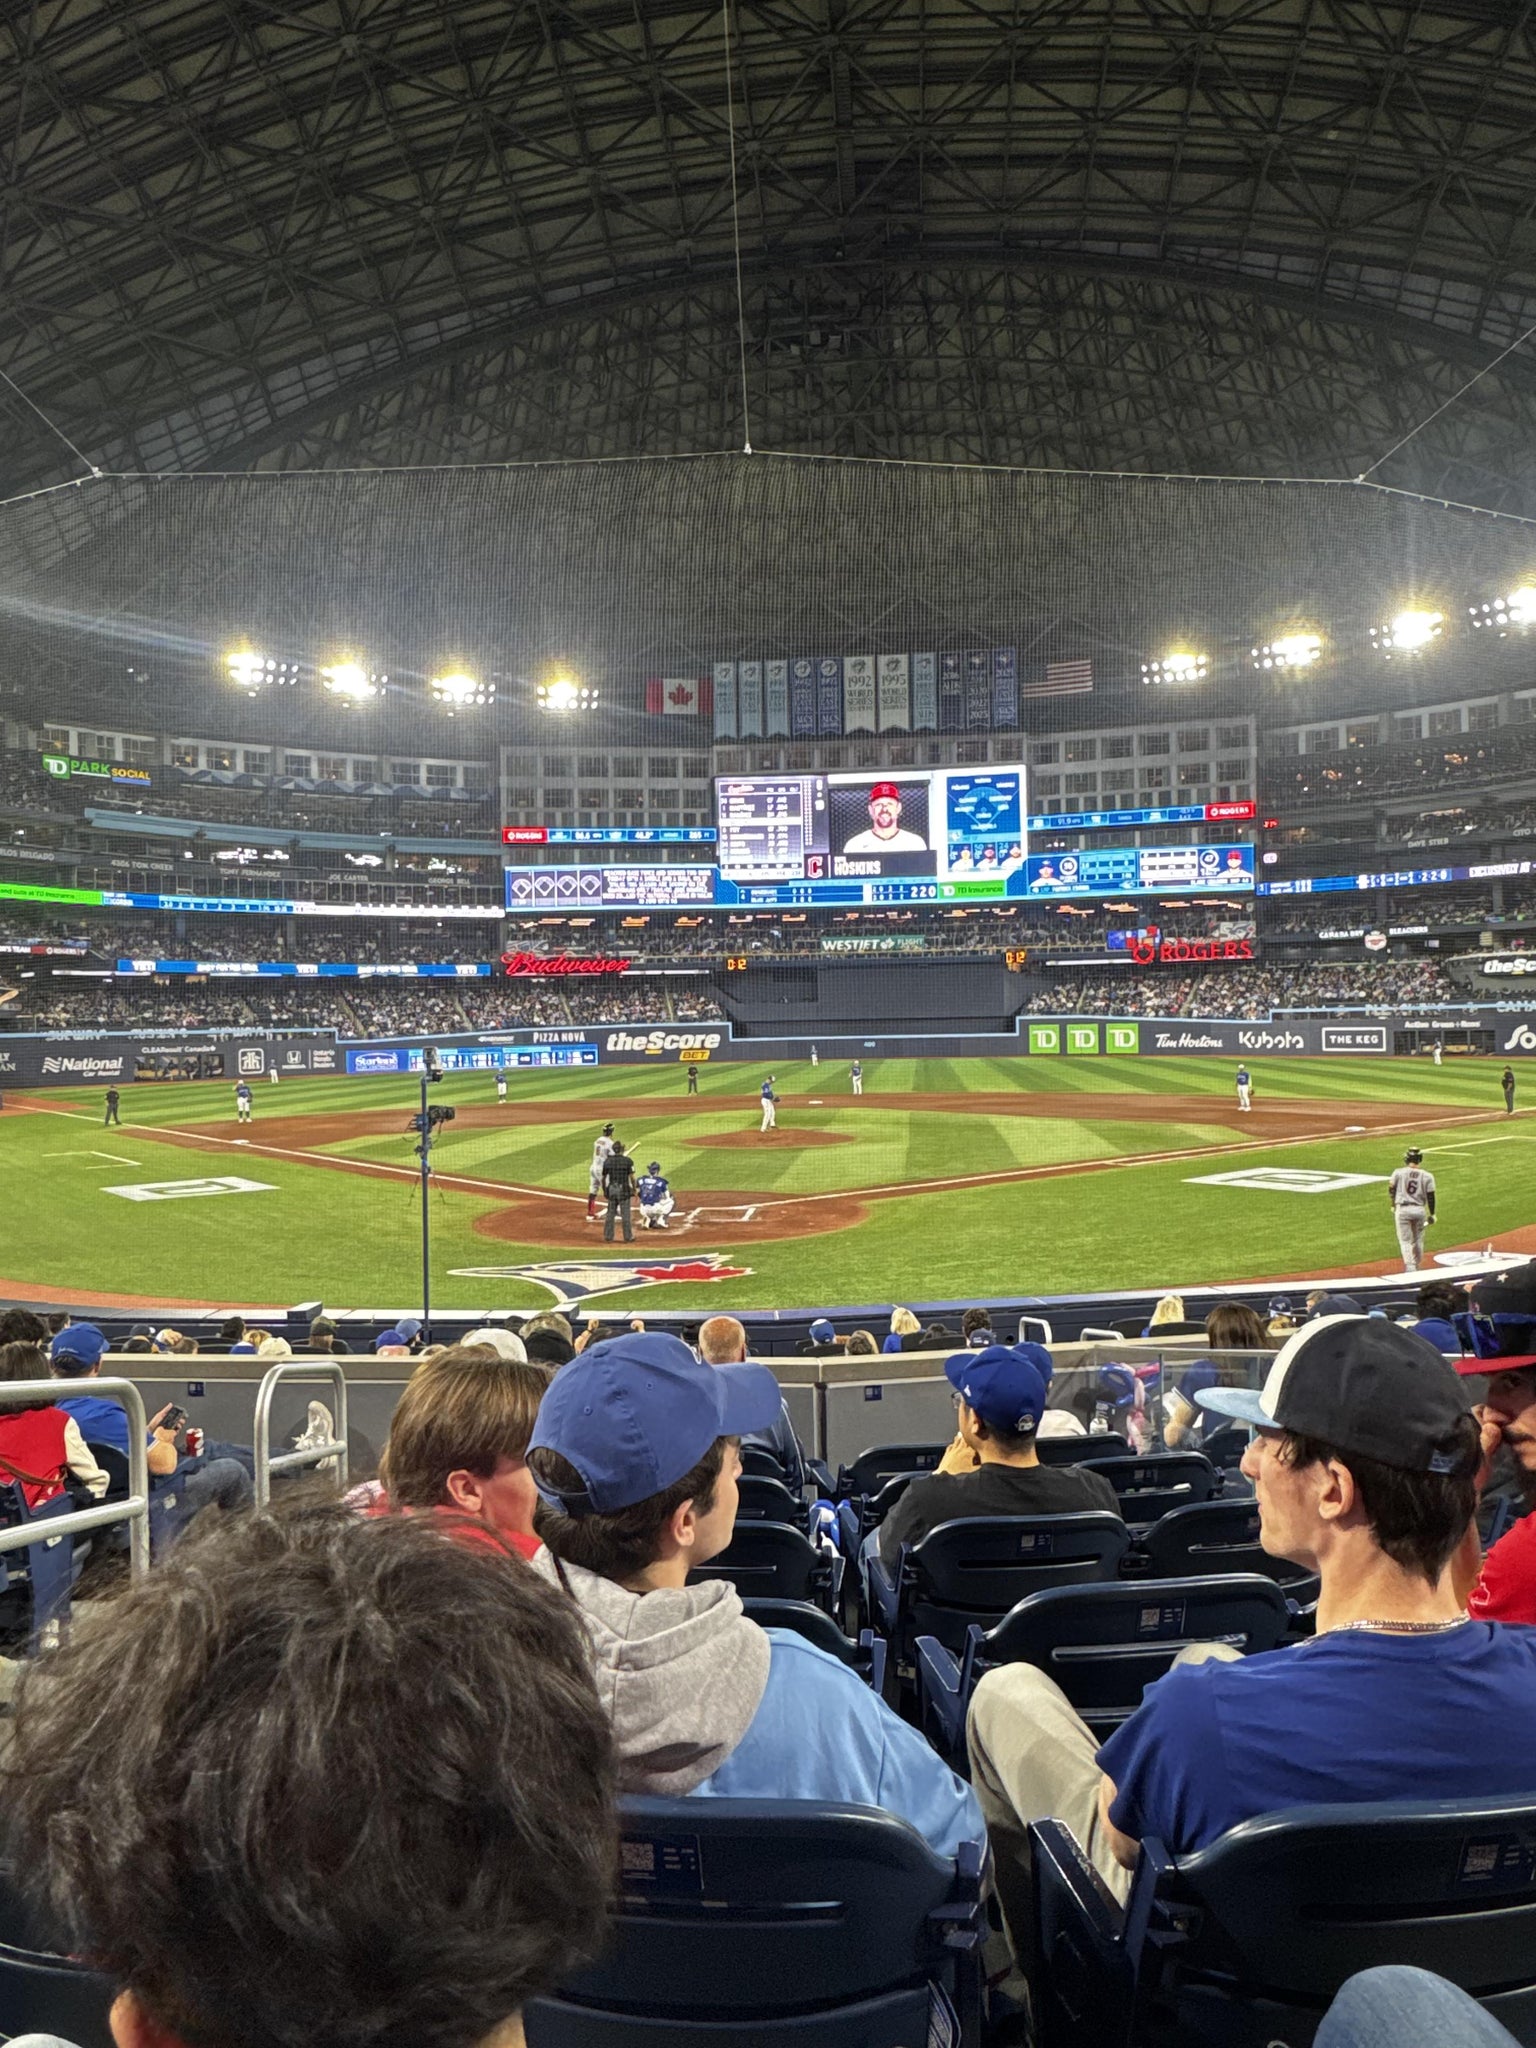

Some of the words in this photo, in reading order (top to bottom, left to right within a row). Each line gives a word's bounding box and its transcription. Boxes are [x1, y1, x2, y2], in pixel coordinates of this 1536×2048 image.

[848, 676, 872, 688] 1992
[44, 757, 67, 775] TD
[71, 760, 111, 774] PARK
[112, 767, 150, 780] SOCIAL
[1219, 806, 1249, 815] ROGERS
[1408, 840, 1425, 848] DAVE
[20, 850, 55, 861] DELGADO
[220, 868, 238, 876] TONY
[834, 861, 881, 876] HOSKINS
[967, 885, 1003, 893] Insurance
[1319, 930, 1349, 938] CANADA
[1389, 926, 1428, 935] BLEACHERS
[1160, 941, 1253, 960] ROGERS
[501, 952, 630, 975] Budweiser
[533, 1032, 559, 1043] PIZZA
[561, 1032, 585, 1043] NOVA
[607, 1031, 720, 1051] theScore
[1032, 1030, 1057, 1048] TD
[1070, 1030, 1095, 1048] TD
[1109, 1029, 1136, 1047] TD
[1155, 1033, 1177, 1048] Tim
[1179, 1033, 1223, 1048] Hortons
[1238, 1031, 1304, 1049] Kubota
[1329, 1035, 1352, 1044] THE
[1356, 1035, 1379, 1044] KEG
[683, 1051, 706, 1059] BET
[61, 1057, 123, 1071] National
[1407, 1180, 1418, 1195] 6
